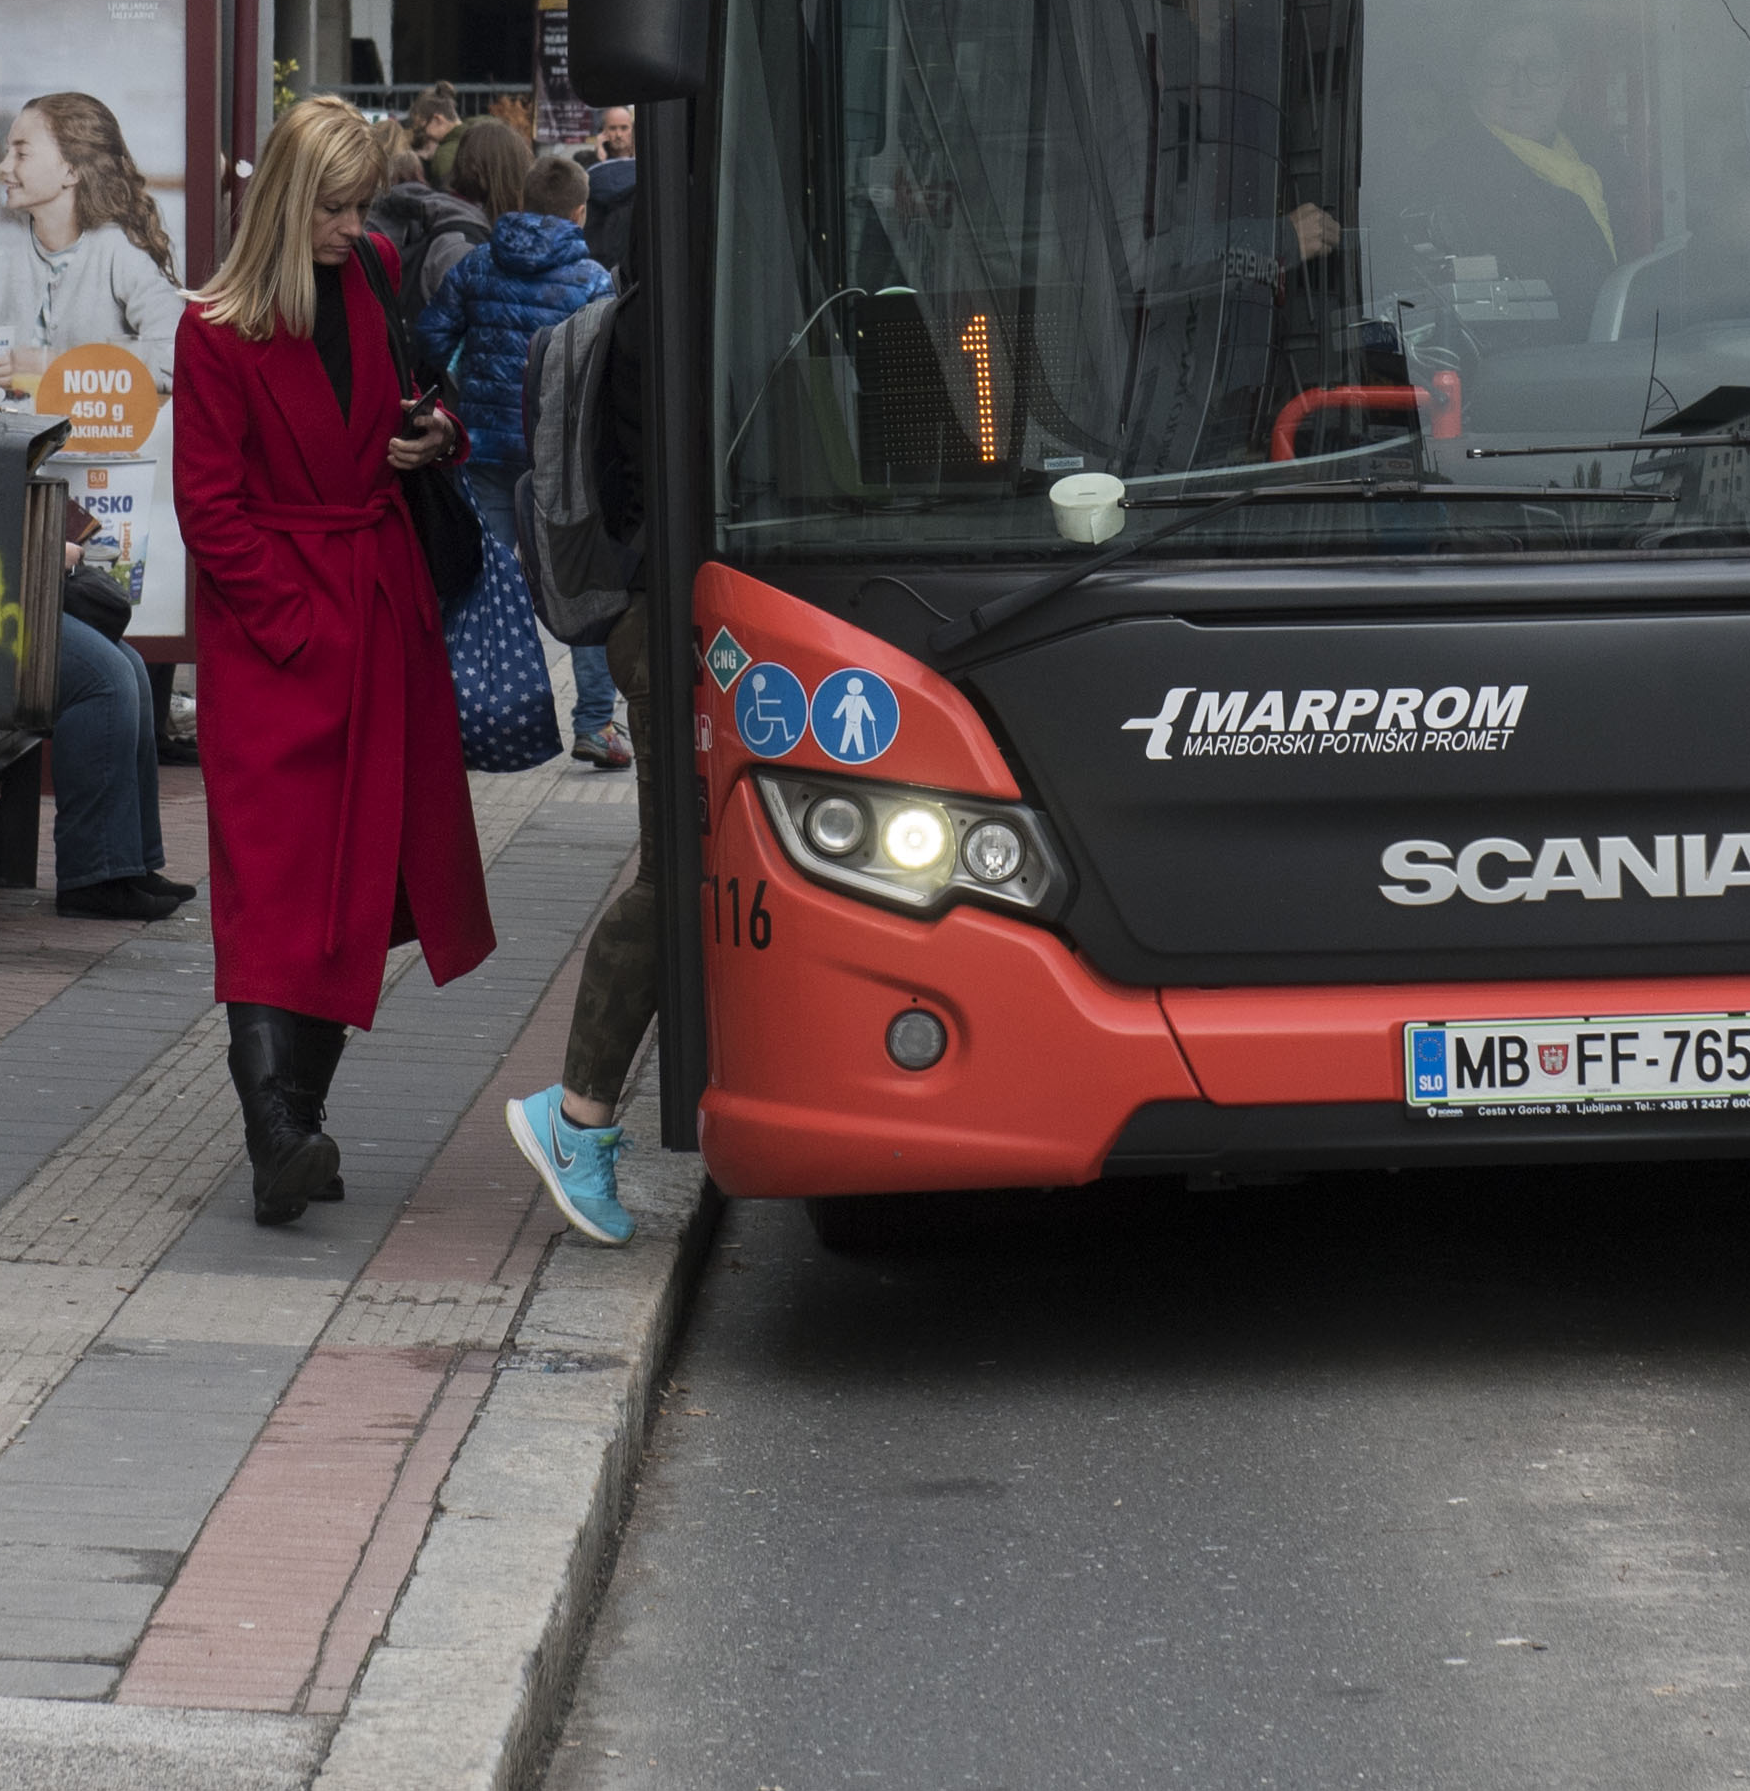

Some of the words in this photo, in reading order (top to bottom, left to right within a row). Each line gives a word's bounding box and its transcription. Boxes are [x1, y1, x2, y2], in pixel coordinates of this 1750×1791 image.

[63, 369, 132, 394] NOVO
[961, 315, 996, 463] 1
[71, 400, 107, 418] 450
[112, 404, 124, 422] g
[70, 425, 134, 438] AKIRANJE
[713, 649, 737, 670] CNG
[1188, 684, 1530, 734] MARPROM
[1182, 734, 1315, 757] MARIBORSKI
[1318, 726, 1418, 755] POTNIŠKI
[1421, 728, 1515, 754] PROMET
[702, 874, 772, 950] 116
[1419, 1074, 1443, 1091] SLO
[1454, 1035, 1531, 1089] MB
[1477, 1105, 1507, 1117] Cesta
[1518, 1105, 1552, 1116] Gorice
[1576, 1101, 1623, 1116] Ljubljana
[1660, 1100, 1689, 1111] +386
[1691, 1100, 1698, 1110] 1
[1701, 1099, 1731, 1110] 2427
